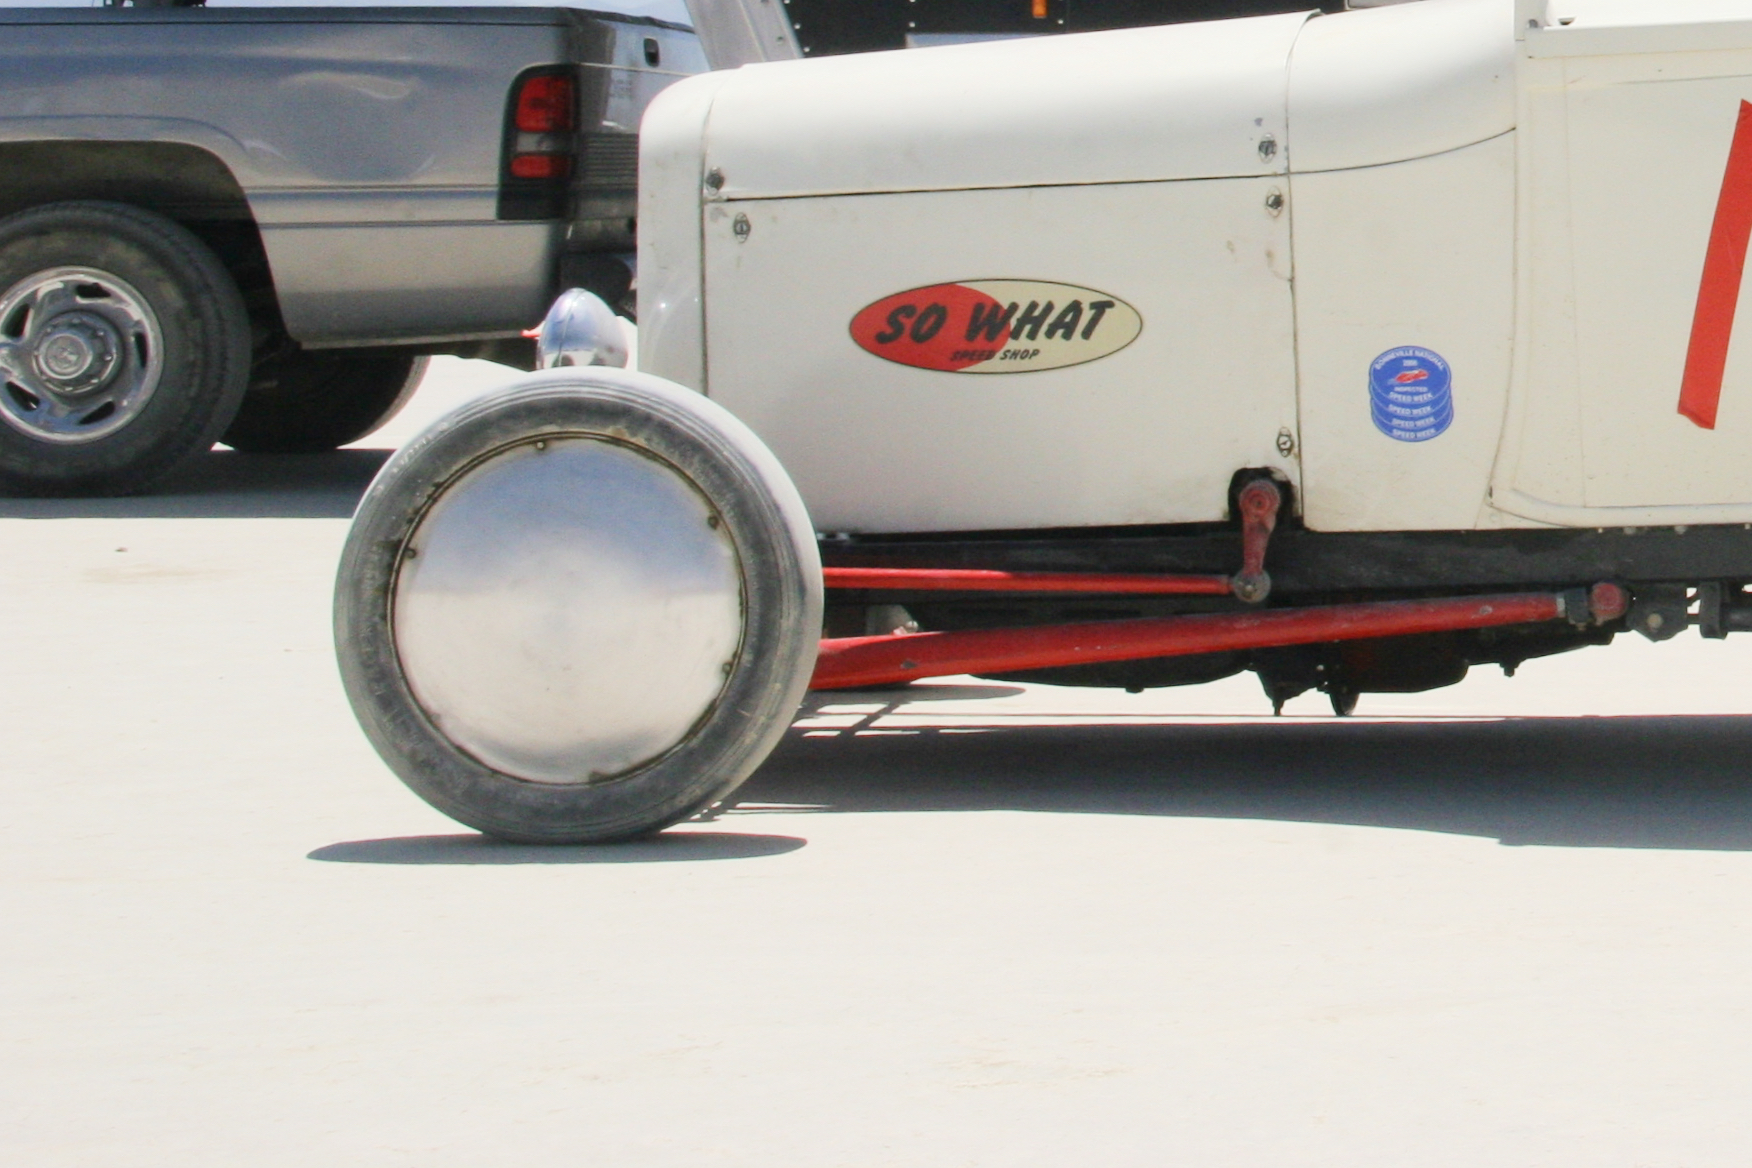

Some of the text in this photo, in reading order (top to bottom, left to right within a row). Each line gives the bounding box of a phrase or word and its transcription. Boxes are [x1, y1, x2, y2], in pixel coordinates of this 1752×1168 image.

[874, 299, 1115, 344] SO WHAT
[949, 348, 1040, 362] SPEED SHOP
[1388, 392, 1433, 403] SPEED WEEK
[1388, 404, 1432, 415] SPEED WEEK
[1391, 416, 1436, 428] SPEED WEEK
[1392, 428, 1437, 439] SPEED WEEK
